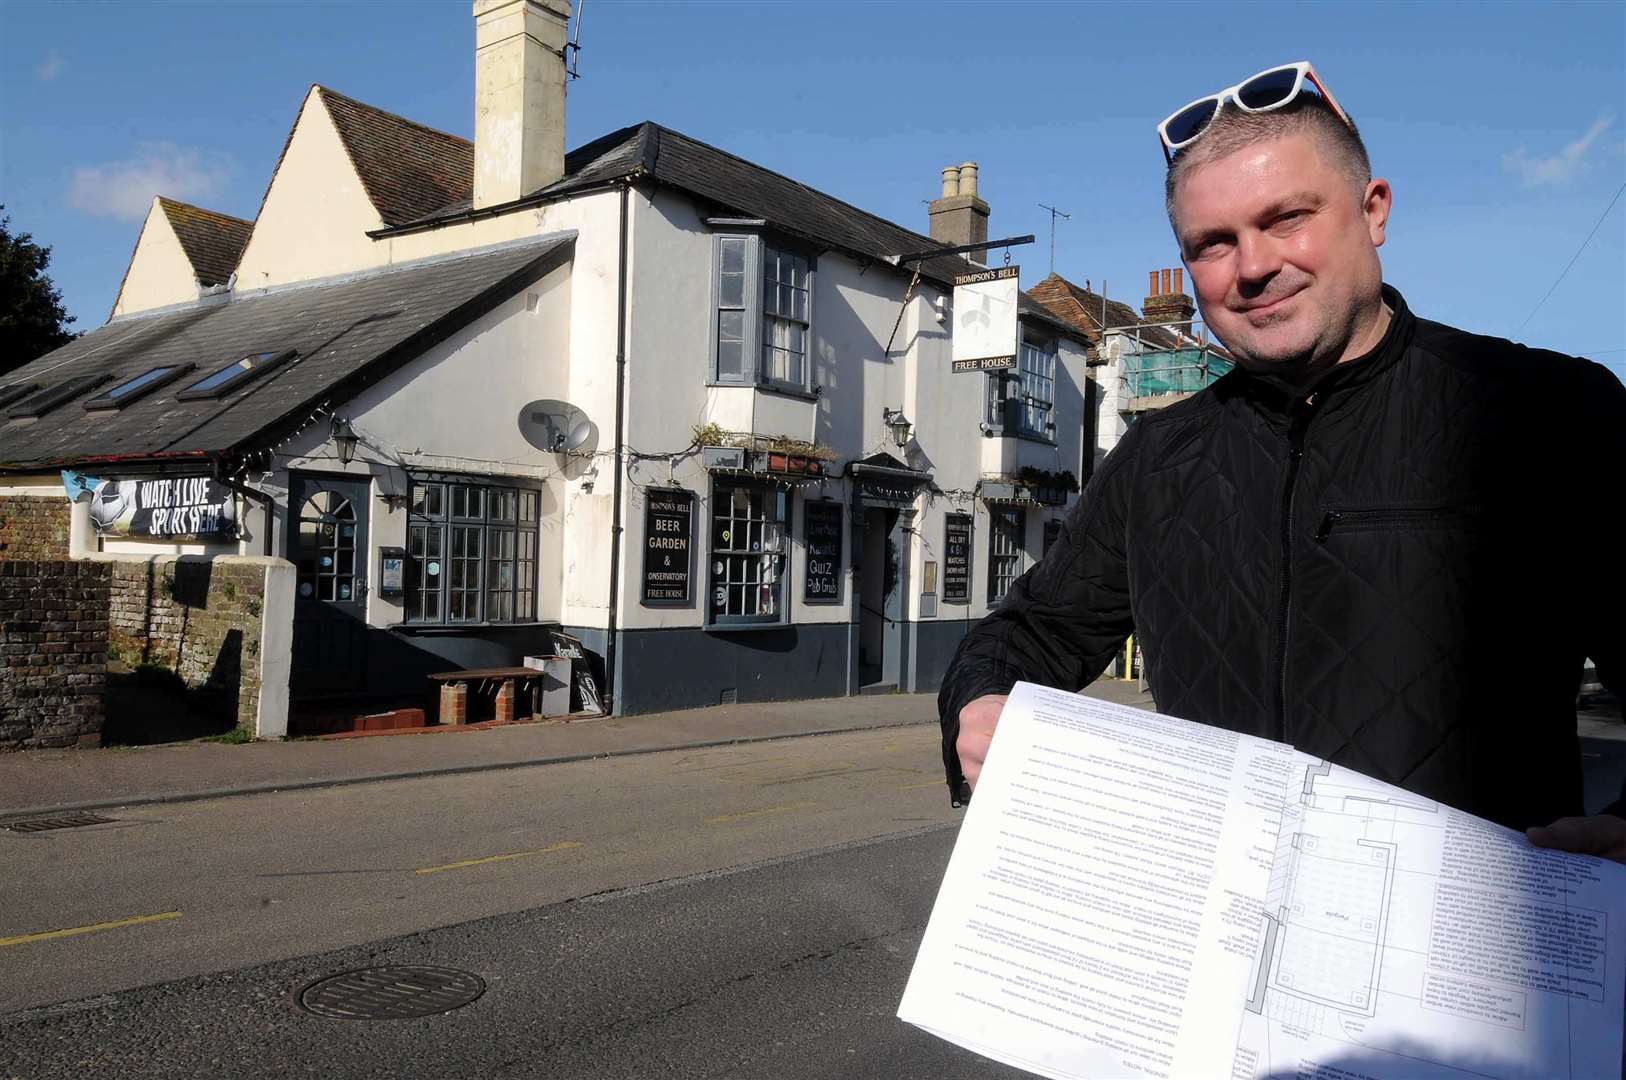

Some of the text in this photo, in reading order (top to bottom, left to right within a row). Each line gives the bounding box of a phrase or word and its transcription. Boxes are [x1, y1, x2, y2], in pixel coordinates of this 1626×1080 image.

[955, 268, 1018, 285] THOMPSON'S BELL
[955, 357, 1012, 370] FREE HOUSE
[141, 477, 211, 509] WATCH LIVE
[149, 503, 222, 534] SPORT HERE
[655, 519, 680, 532] BEER
[648, 537, 686, 550] GARDEN
[663, 555, 671, 566] &
[648, 572, 687, 581] ONSERVATORY
[647, 589, 664, 598] FREE
